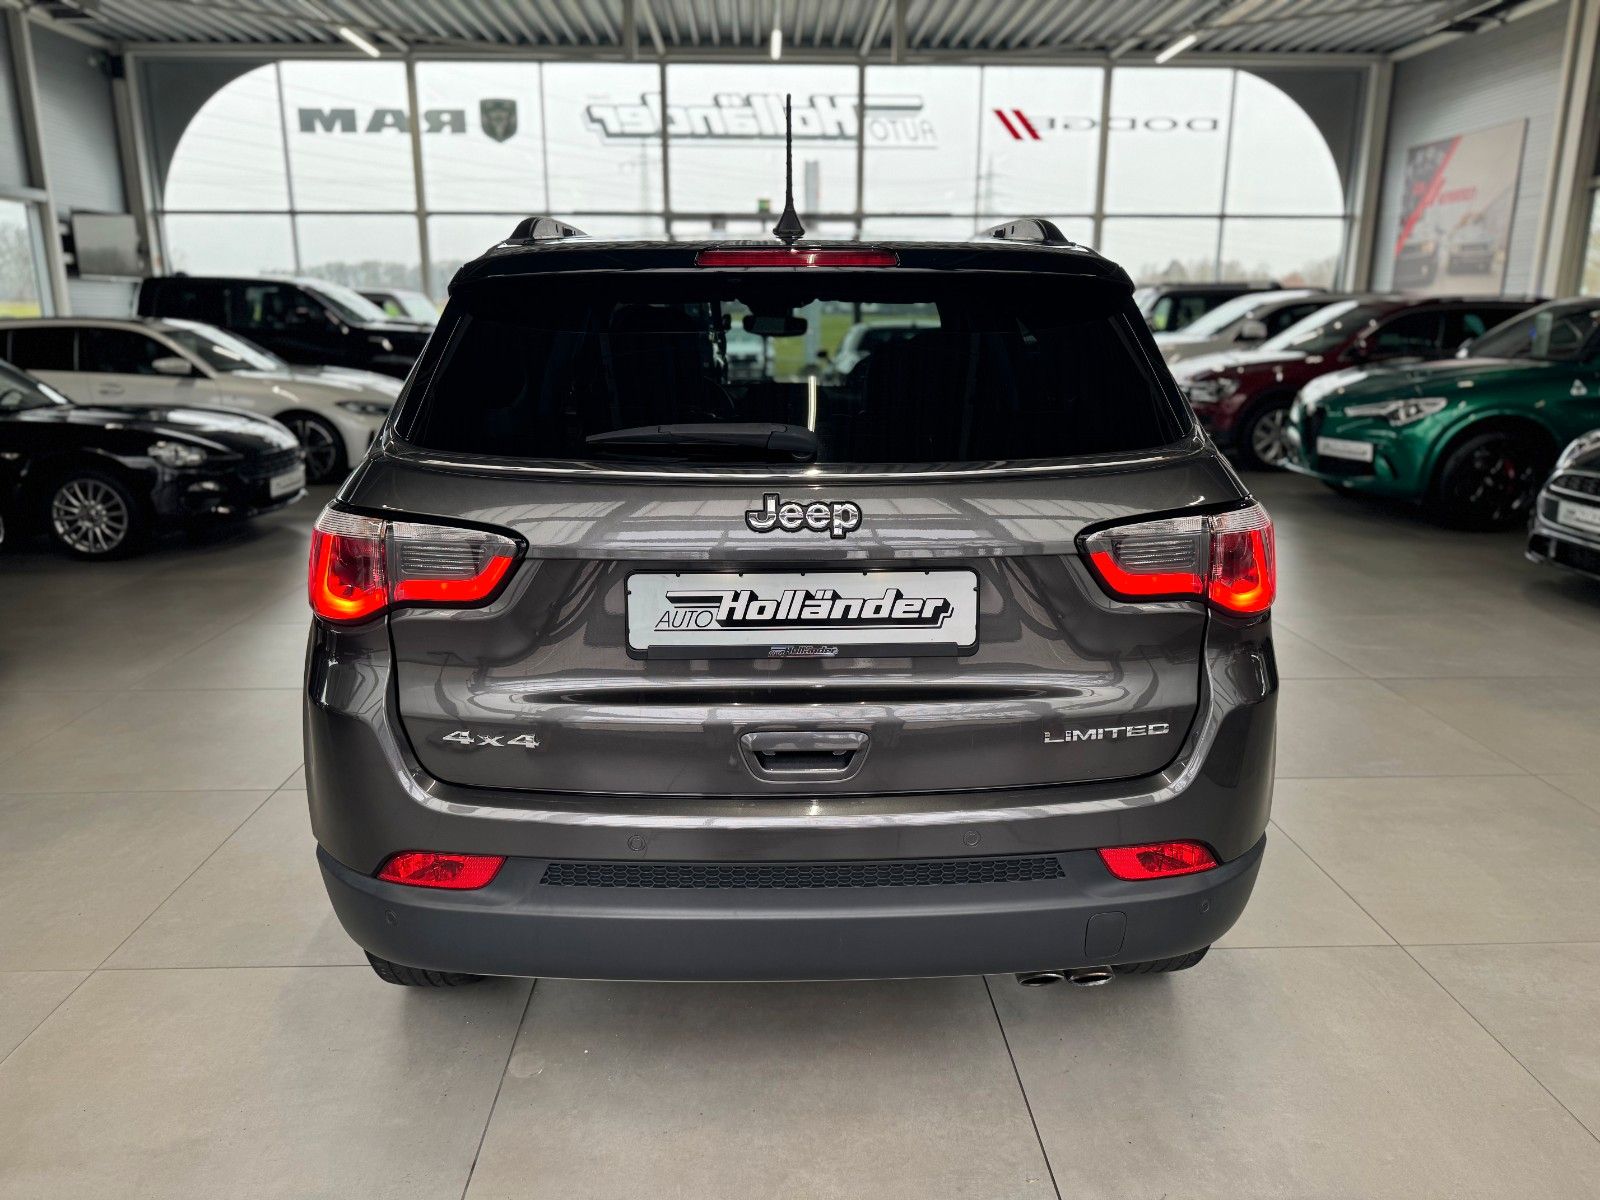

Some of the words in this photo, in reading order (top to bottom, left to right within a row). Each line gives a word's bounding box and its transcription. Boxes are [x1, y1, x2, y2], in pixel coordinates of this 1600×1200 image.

[745, 492, 863, 539] Jeep
[655, 610, 714, 629] AUTO
[715, 587, 955, 627] Holländer
[442, 730, 540, 749] 4x4
